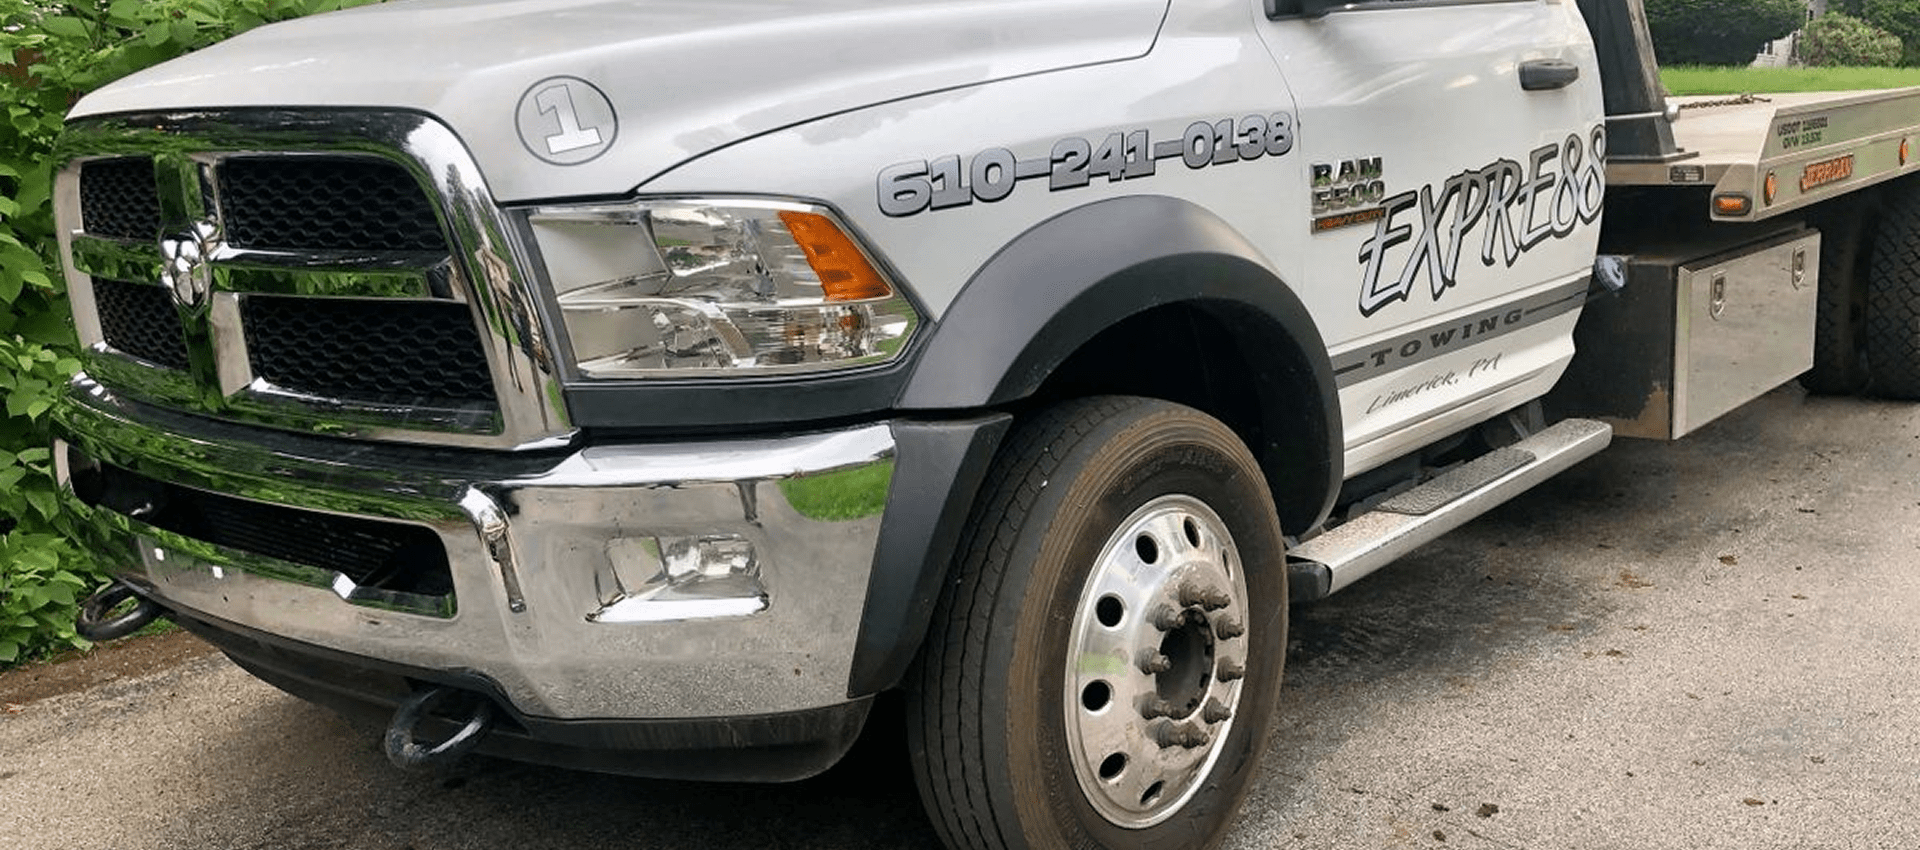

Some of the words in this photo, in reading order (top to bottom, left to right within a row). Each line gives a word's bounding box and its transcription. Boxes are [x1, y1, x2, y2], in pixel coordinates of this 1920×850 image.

[535, 83, 603, 155] 1
[876, 111, 1294, 217] 610-241-0138
[1309, 156, 1383, 188] RAM
[1311, 180, 1386, 215] 5500
[1358, 124, 1605, 318] EXPRESS
[1370, 309, 1523, 367] TOWING
[1366, 371, 1459, 414] Limerick,
[1468, 353, 1502, 378] PA
